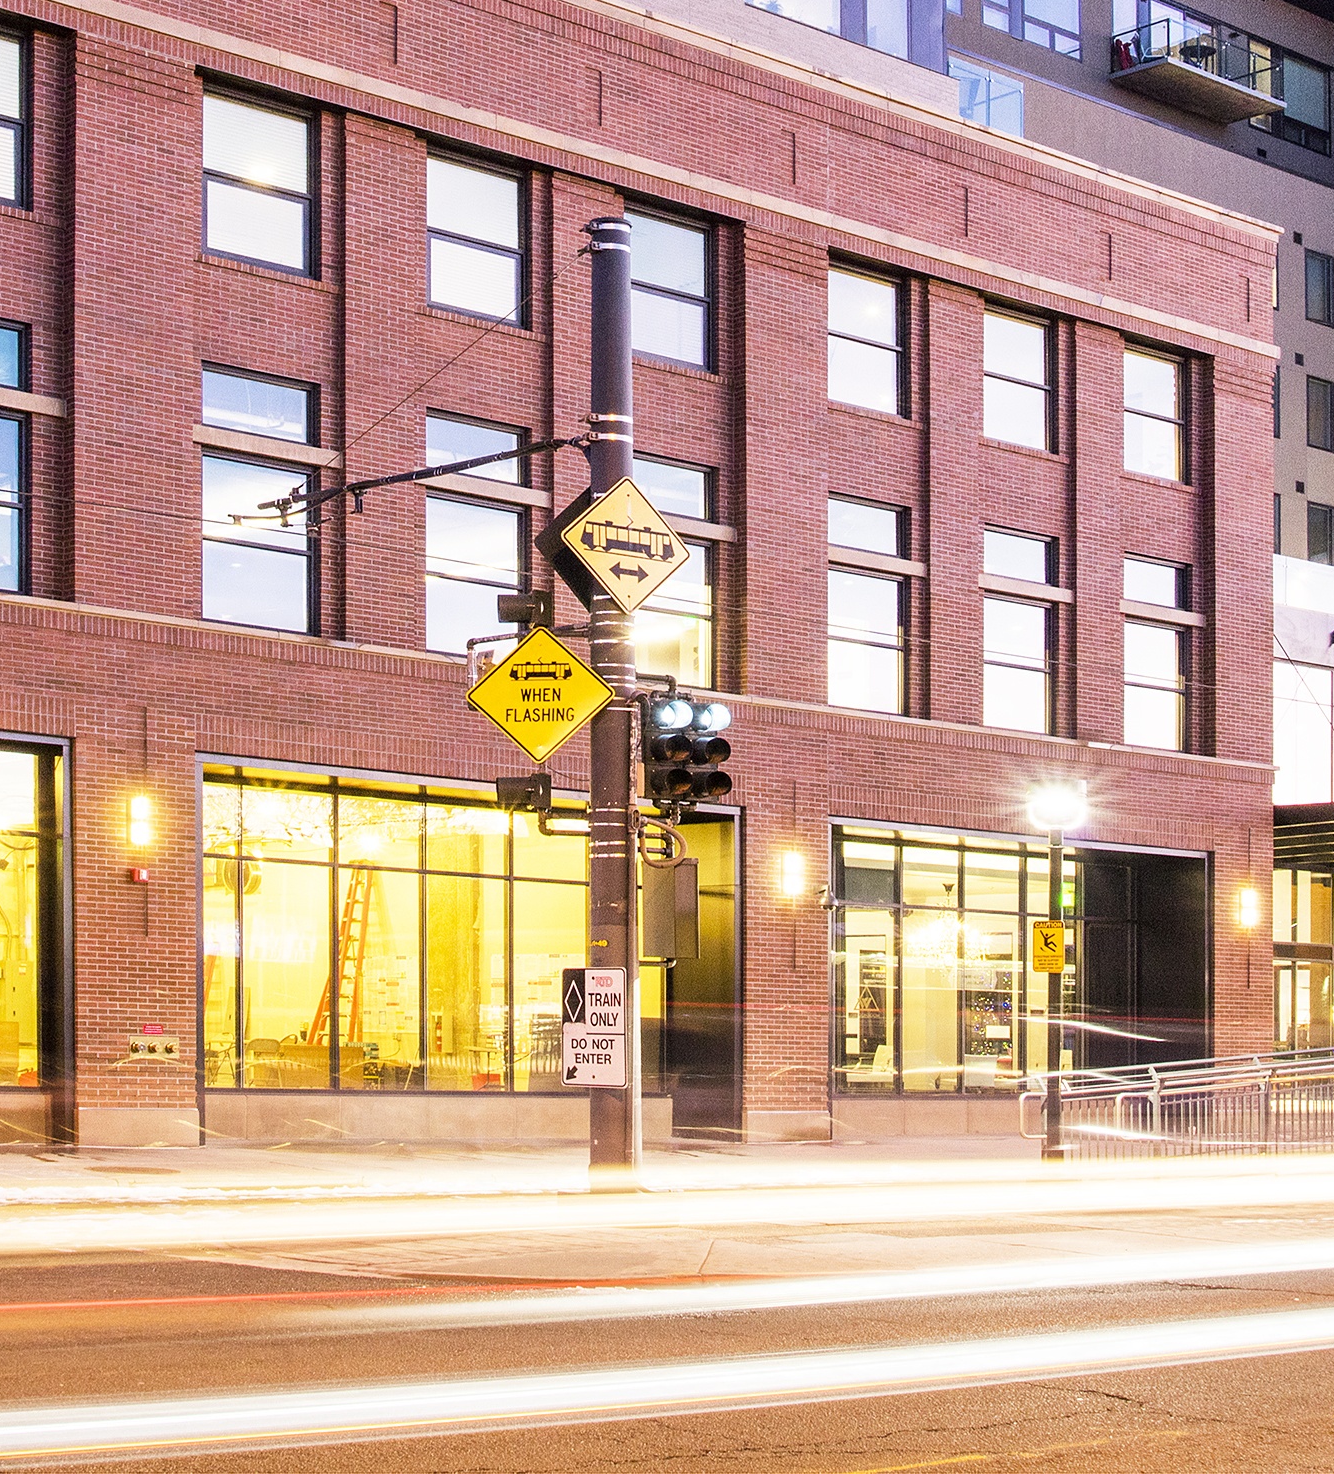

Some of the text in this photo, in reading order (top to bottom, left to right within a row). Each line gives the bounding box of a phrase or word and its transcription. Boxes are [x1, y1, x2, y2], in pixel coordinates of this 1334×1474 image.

[521, 688, 561, 702] WHEN
[505, 708, 575, 722] FLASHING
[588, 993, 621, 1007] TRAIN
[590, 1012, 619, 1026] ONLY
[571, 1039, 615, 1050] DO NOT
[575, 1053, 612, 1064] ENTER
